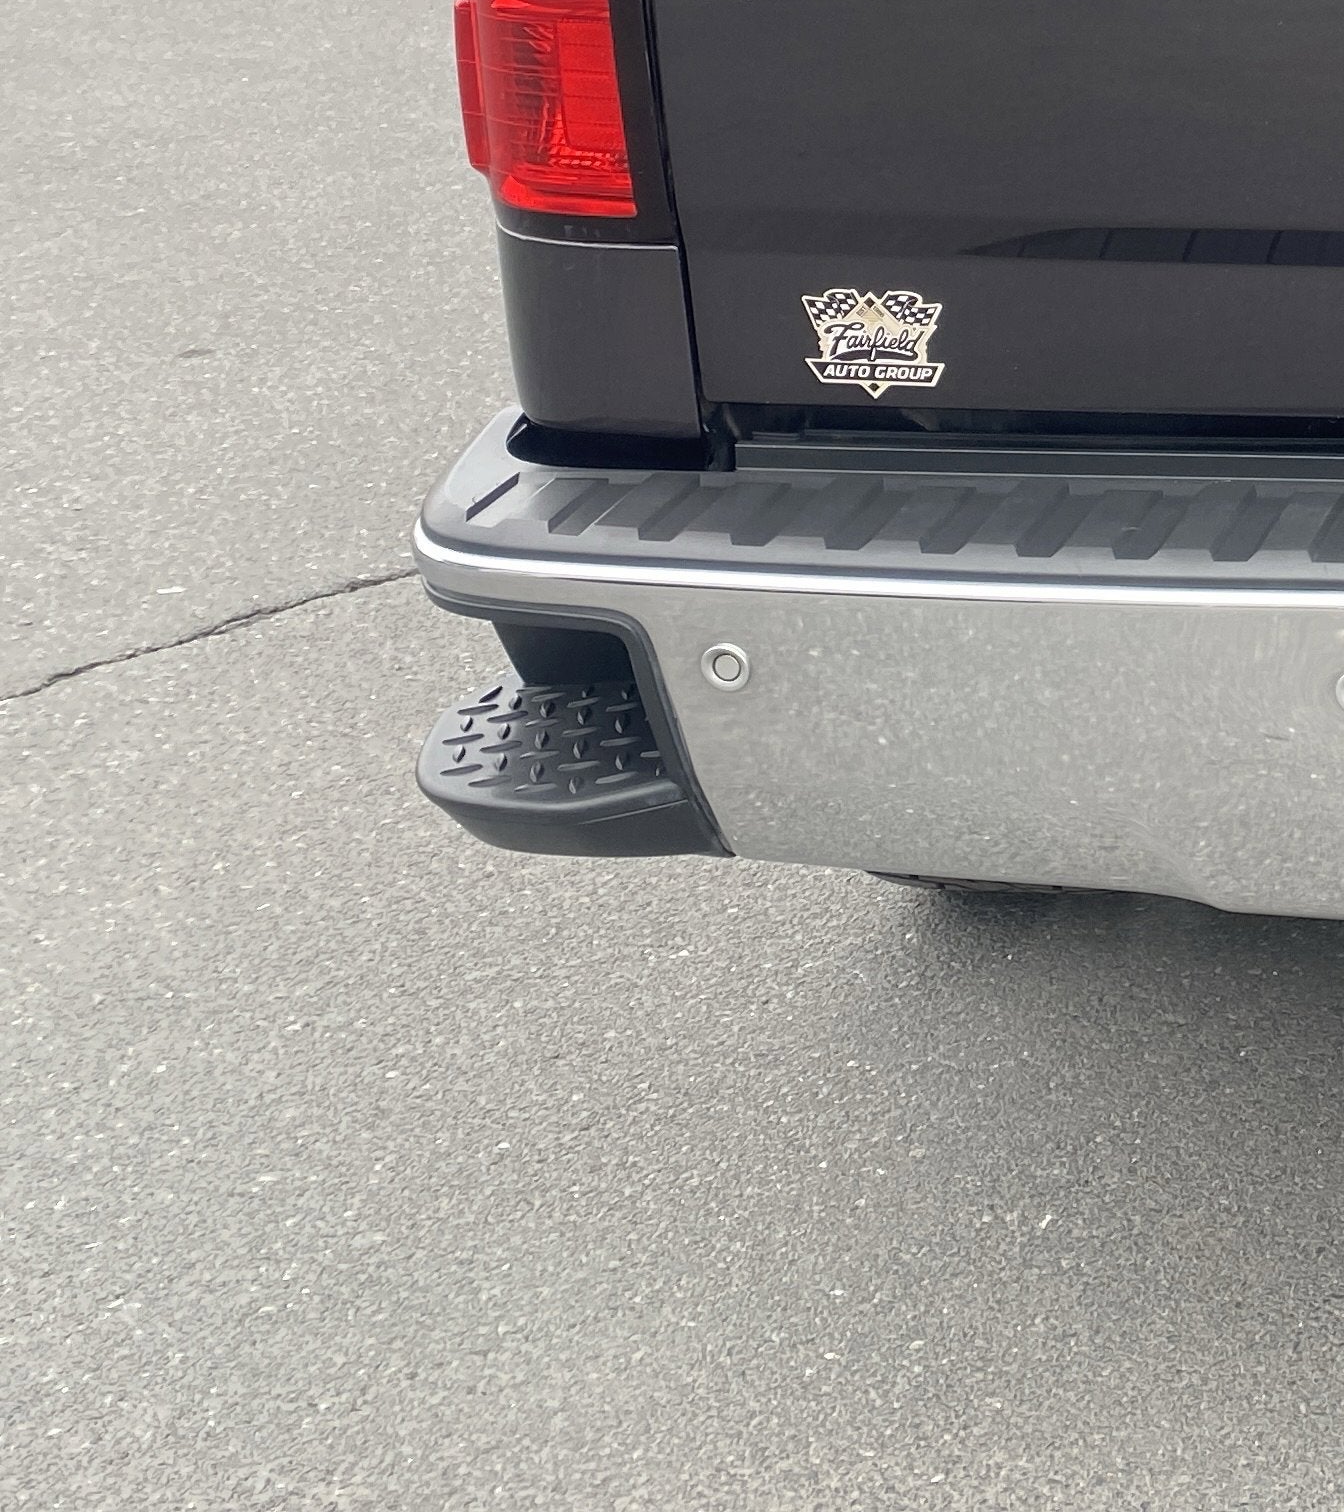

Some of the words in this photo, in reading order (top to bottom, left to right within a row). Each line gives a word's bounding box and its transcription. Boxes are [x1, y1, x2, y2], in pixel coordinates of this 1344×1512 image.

[824, 322, 925, 362] Fairfield
[823, 364, 871, 378] AUTO
[874, 366, 933, 380] GROUP
